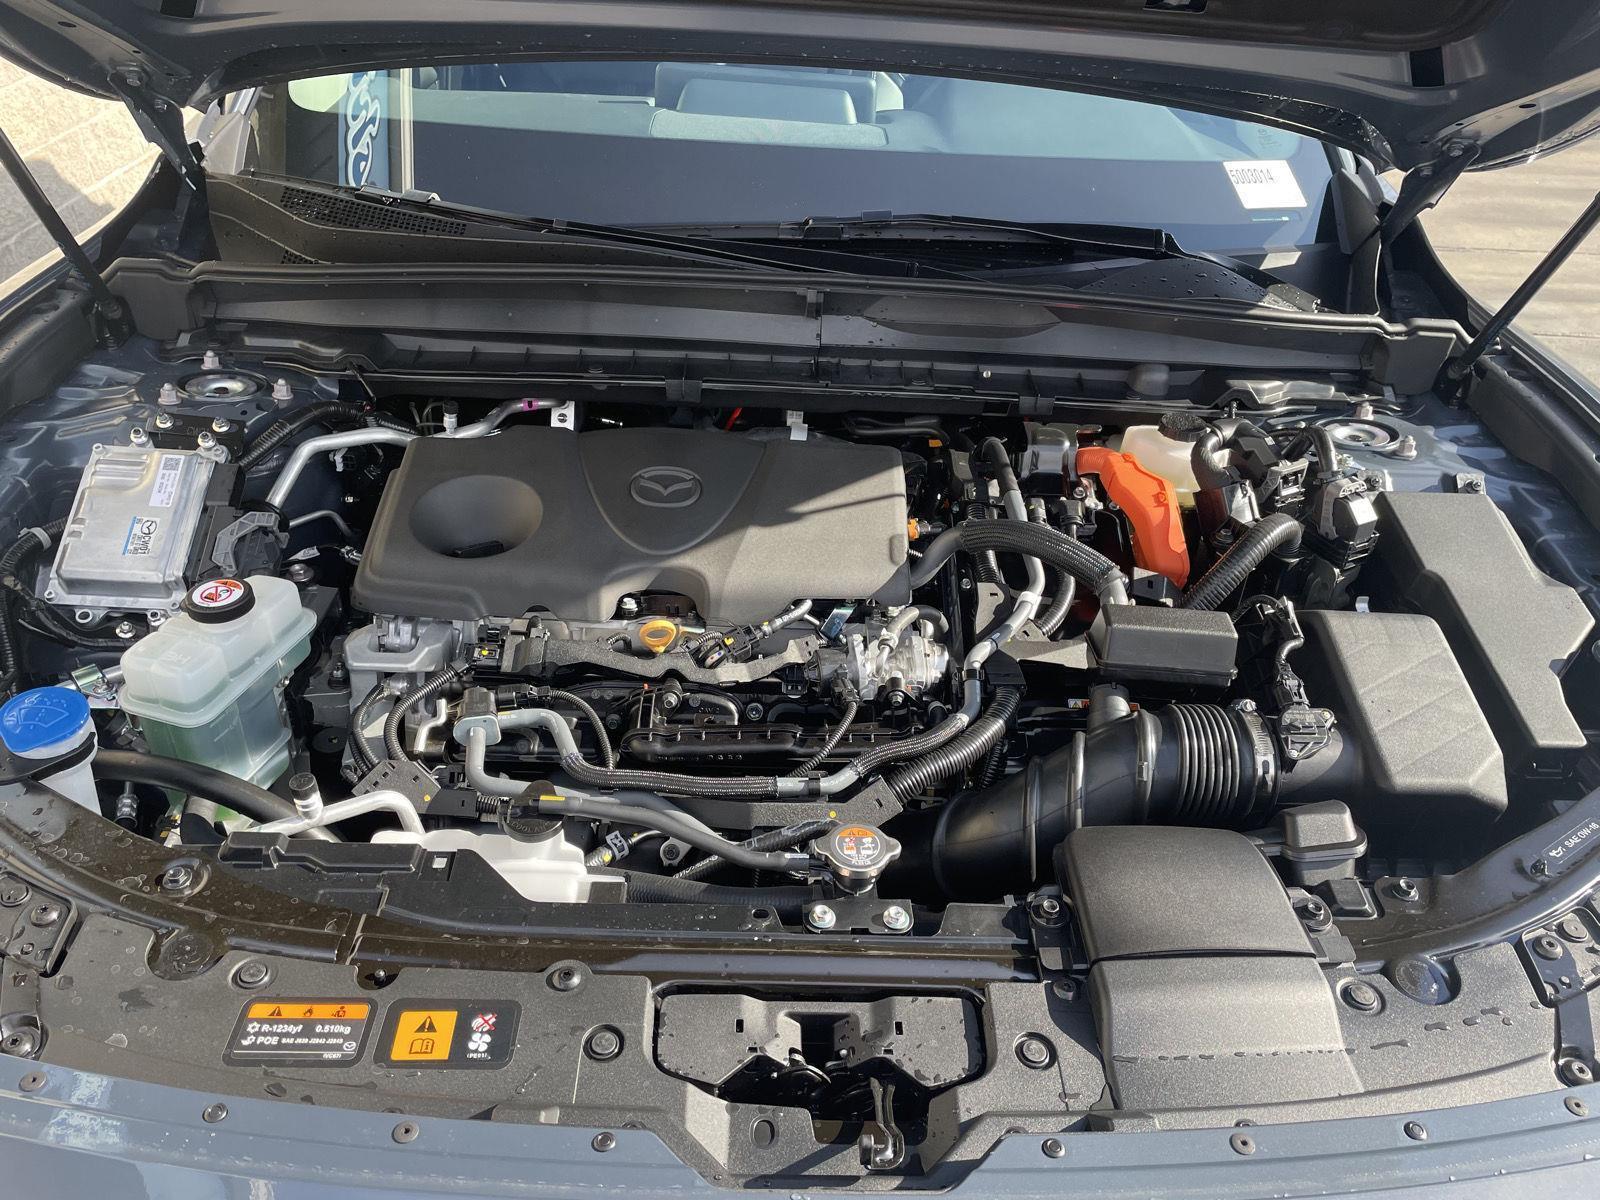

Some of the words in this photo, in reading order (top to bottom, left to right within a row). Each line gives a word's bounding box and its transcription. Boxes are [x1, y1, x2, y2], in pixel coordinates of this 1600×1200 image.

[1564, 835, 1581, 848] SAE
[261, 1024, 303, 1034] R-1234yf
[315, 1025, 351, 1035] 0.510kg
[256, 1036, 279, 1046] POE
